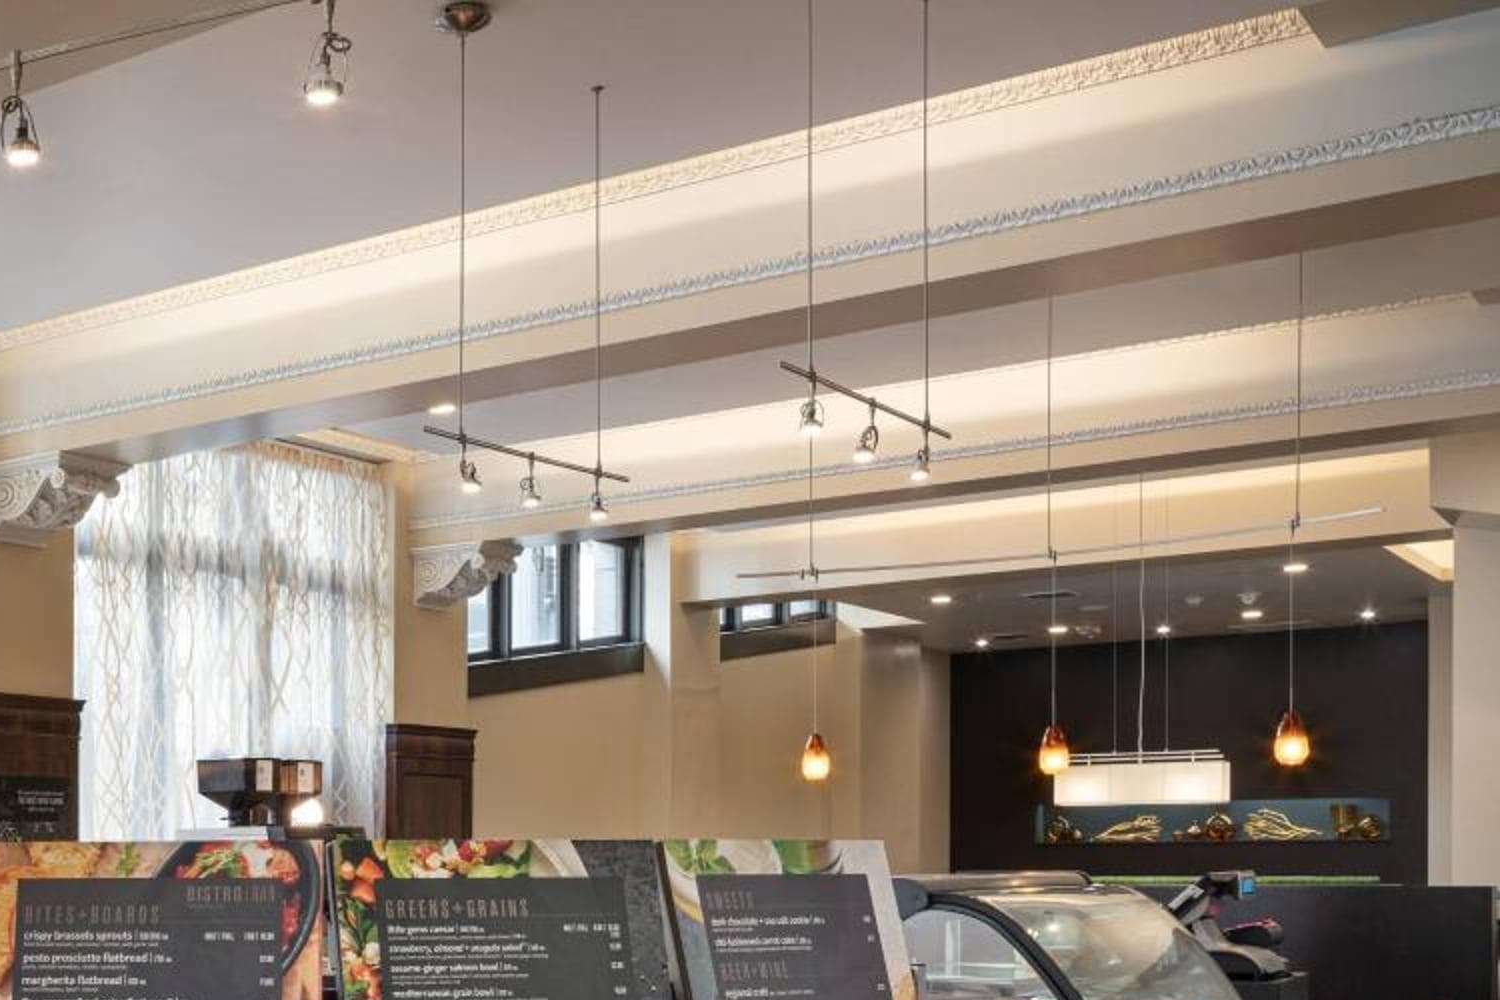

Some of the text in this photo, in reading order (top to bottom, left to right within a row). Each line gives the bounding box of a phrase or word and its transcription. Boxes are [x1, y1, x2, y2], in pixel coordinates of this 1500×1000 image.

[385, 898, 529, 919] GREENS+GRAINS
[23, 930, 52, 943] crispy
[95, 931, 133, 943] sprouts
[22, 953, 50, 965] pesto
[50, 953, 101, 965] prosciutto
[102, 953, 149, 964] flatbread
[21, 976, 76, 988] margherita
[77, 975, 123, 986] flatbread
